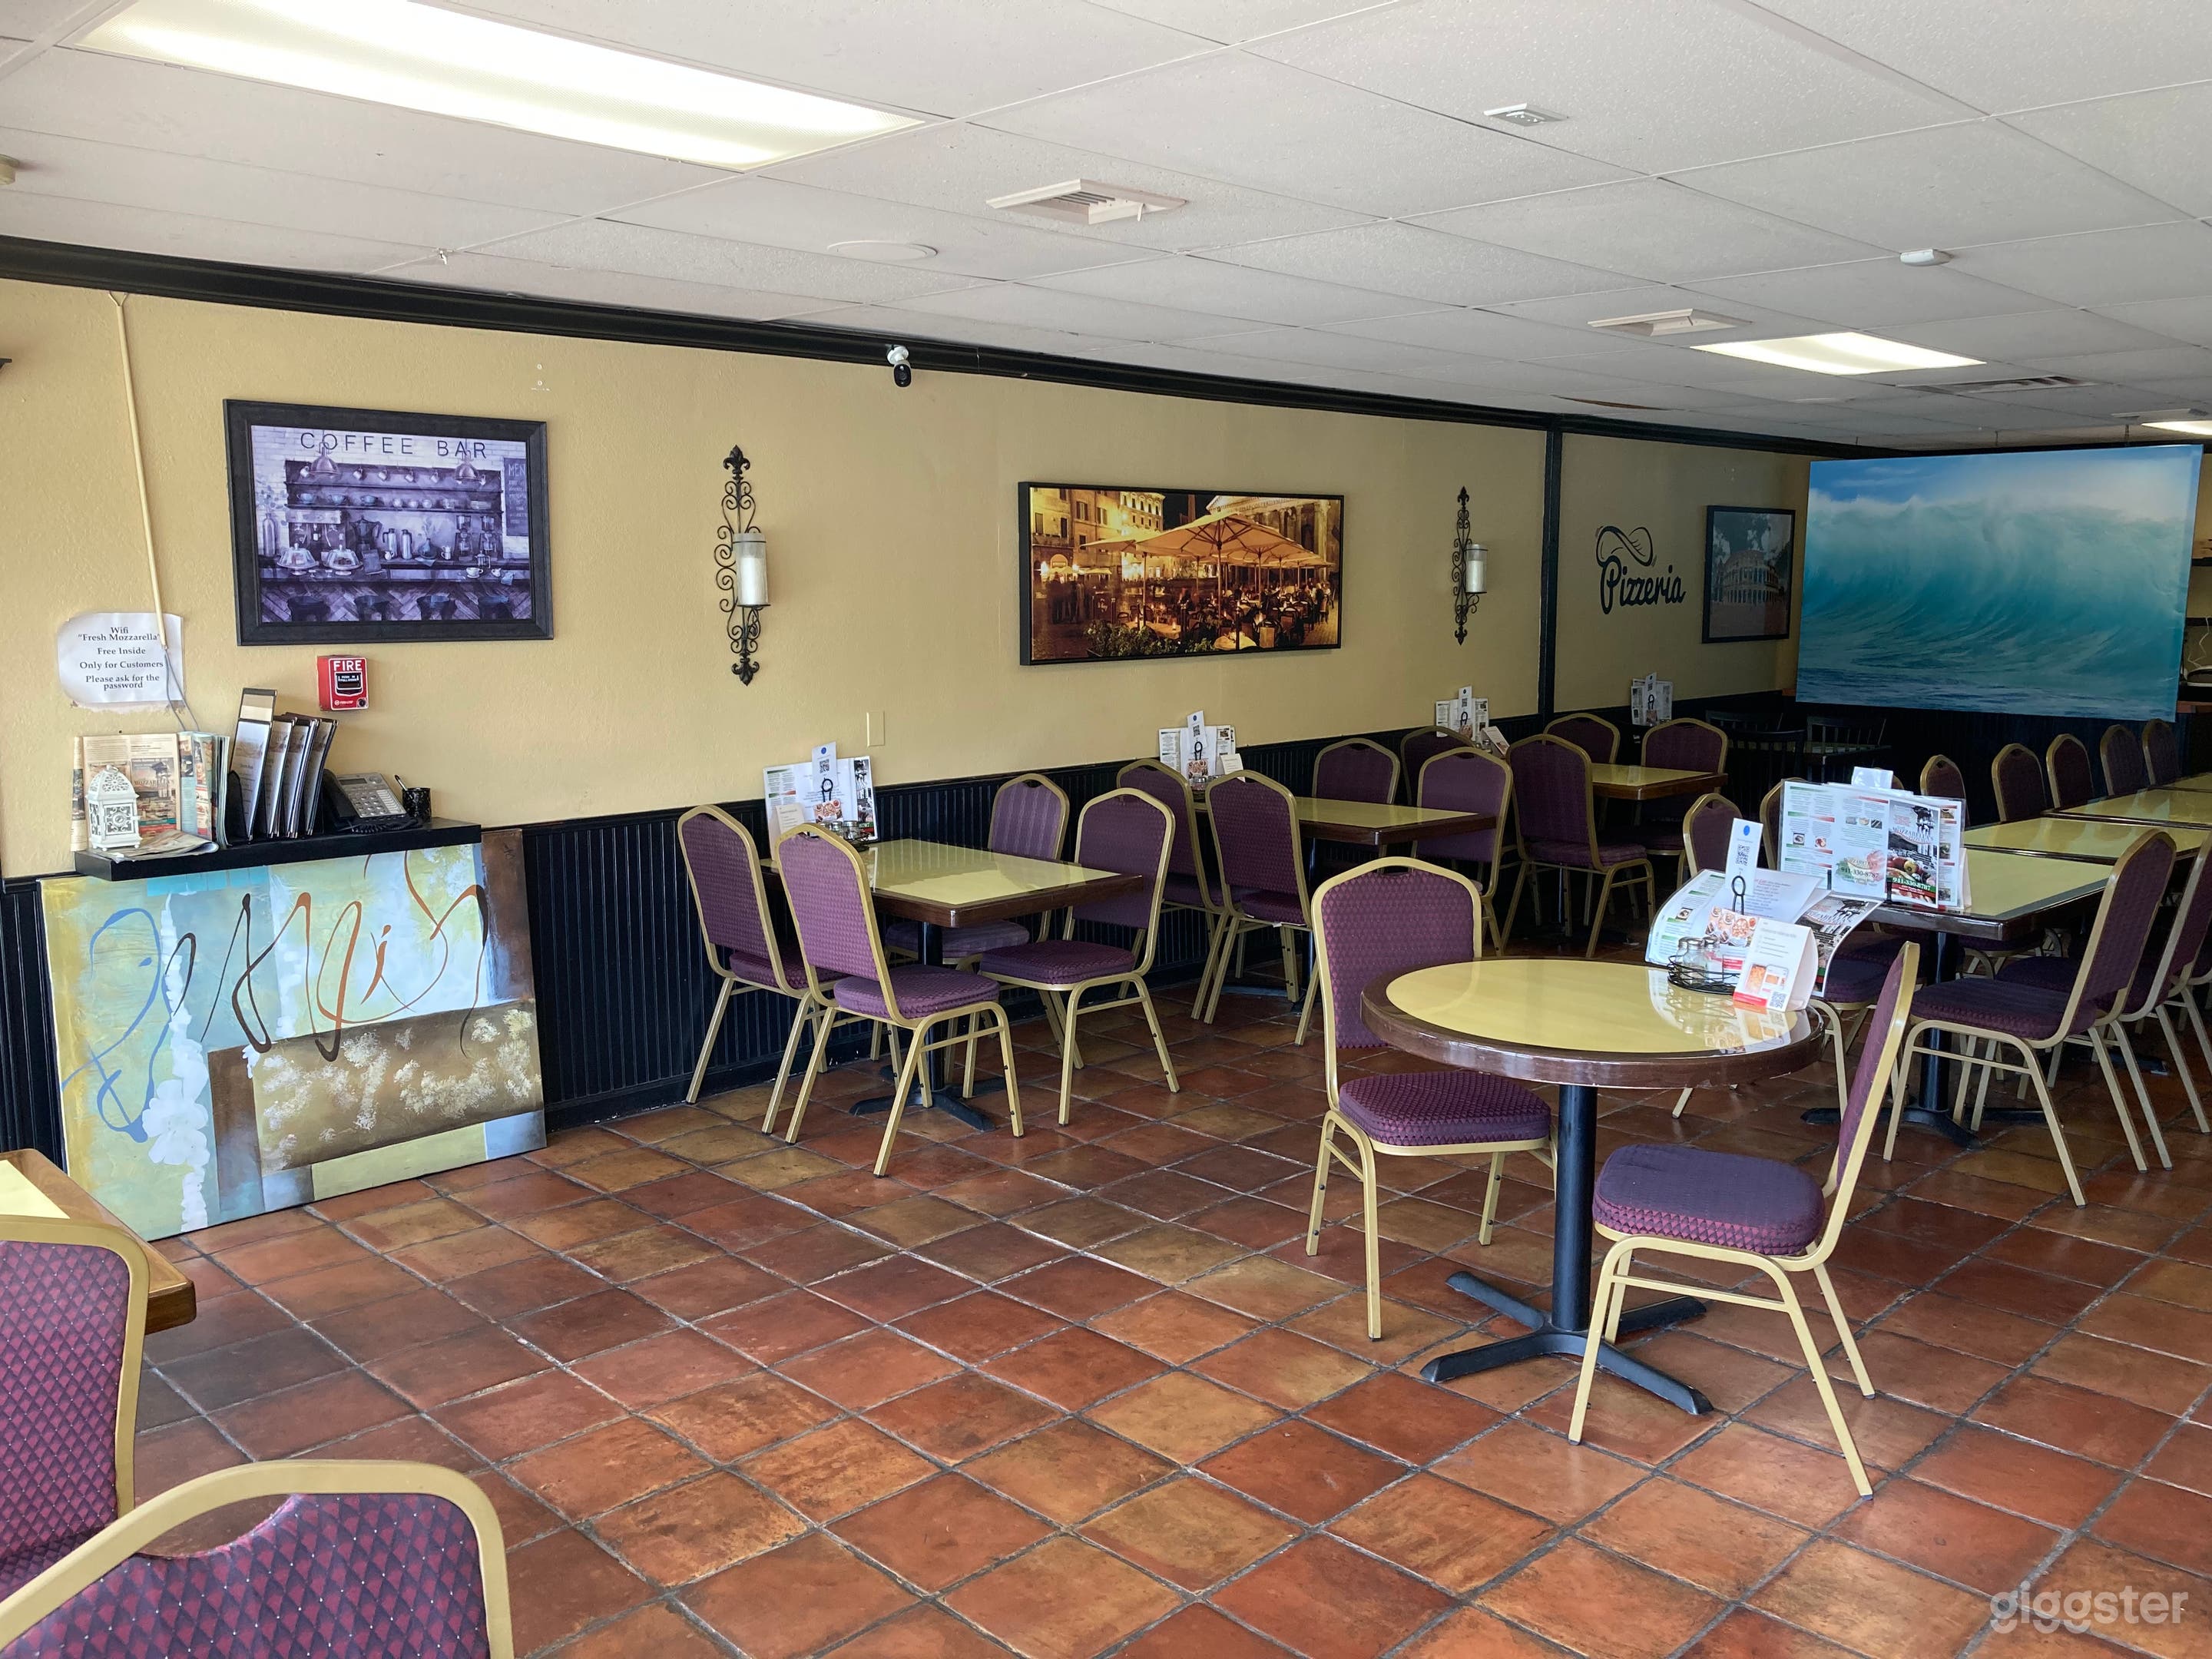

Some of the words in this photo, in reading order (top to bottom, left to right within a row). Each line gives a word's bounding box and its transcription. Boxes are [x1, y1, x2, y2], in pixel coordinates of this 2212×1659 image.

[300, 432, 413, 455] COFFEE
[437, 440, 487, 459] BAR
[1600, 555, 1687, 614] Pizzeria
[111, 626, 129, 634] Wifi
[98, 647, 117, 655] Free
[79, 661, 103, 671] Only
[120, 661, 164, 669] Customers
[333, 660, 363, 671] FIRE
[104, 681, 144, 691] password
[1840, 866, 1879, 879] 941-330-8787
[1892, 876, 1931, 891] 941-330-8787
